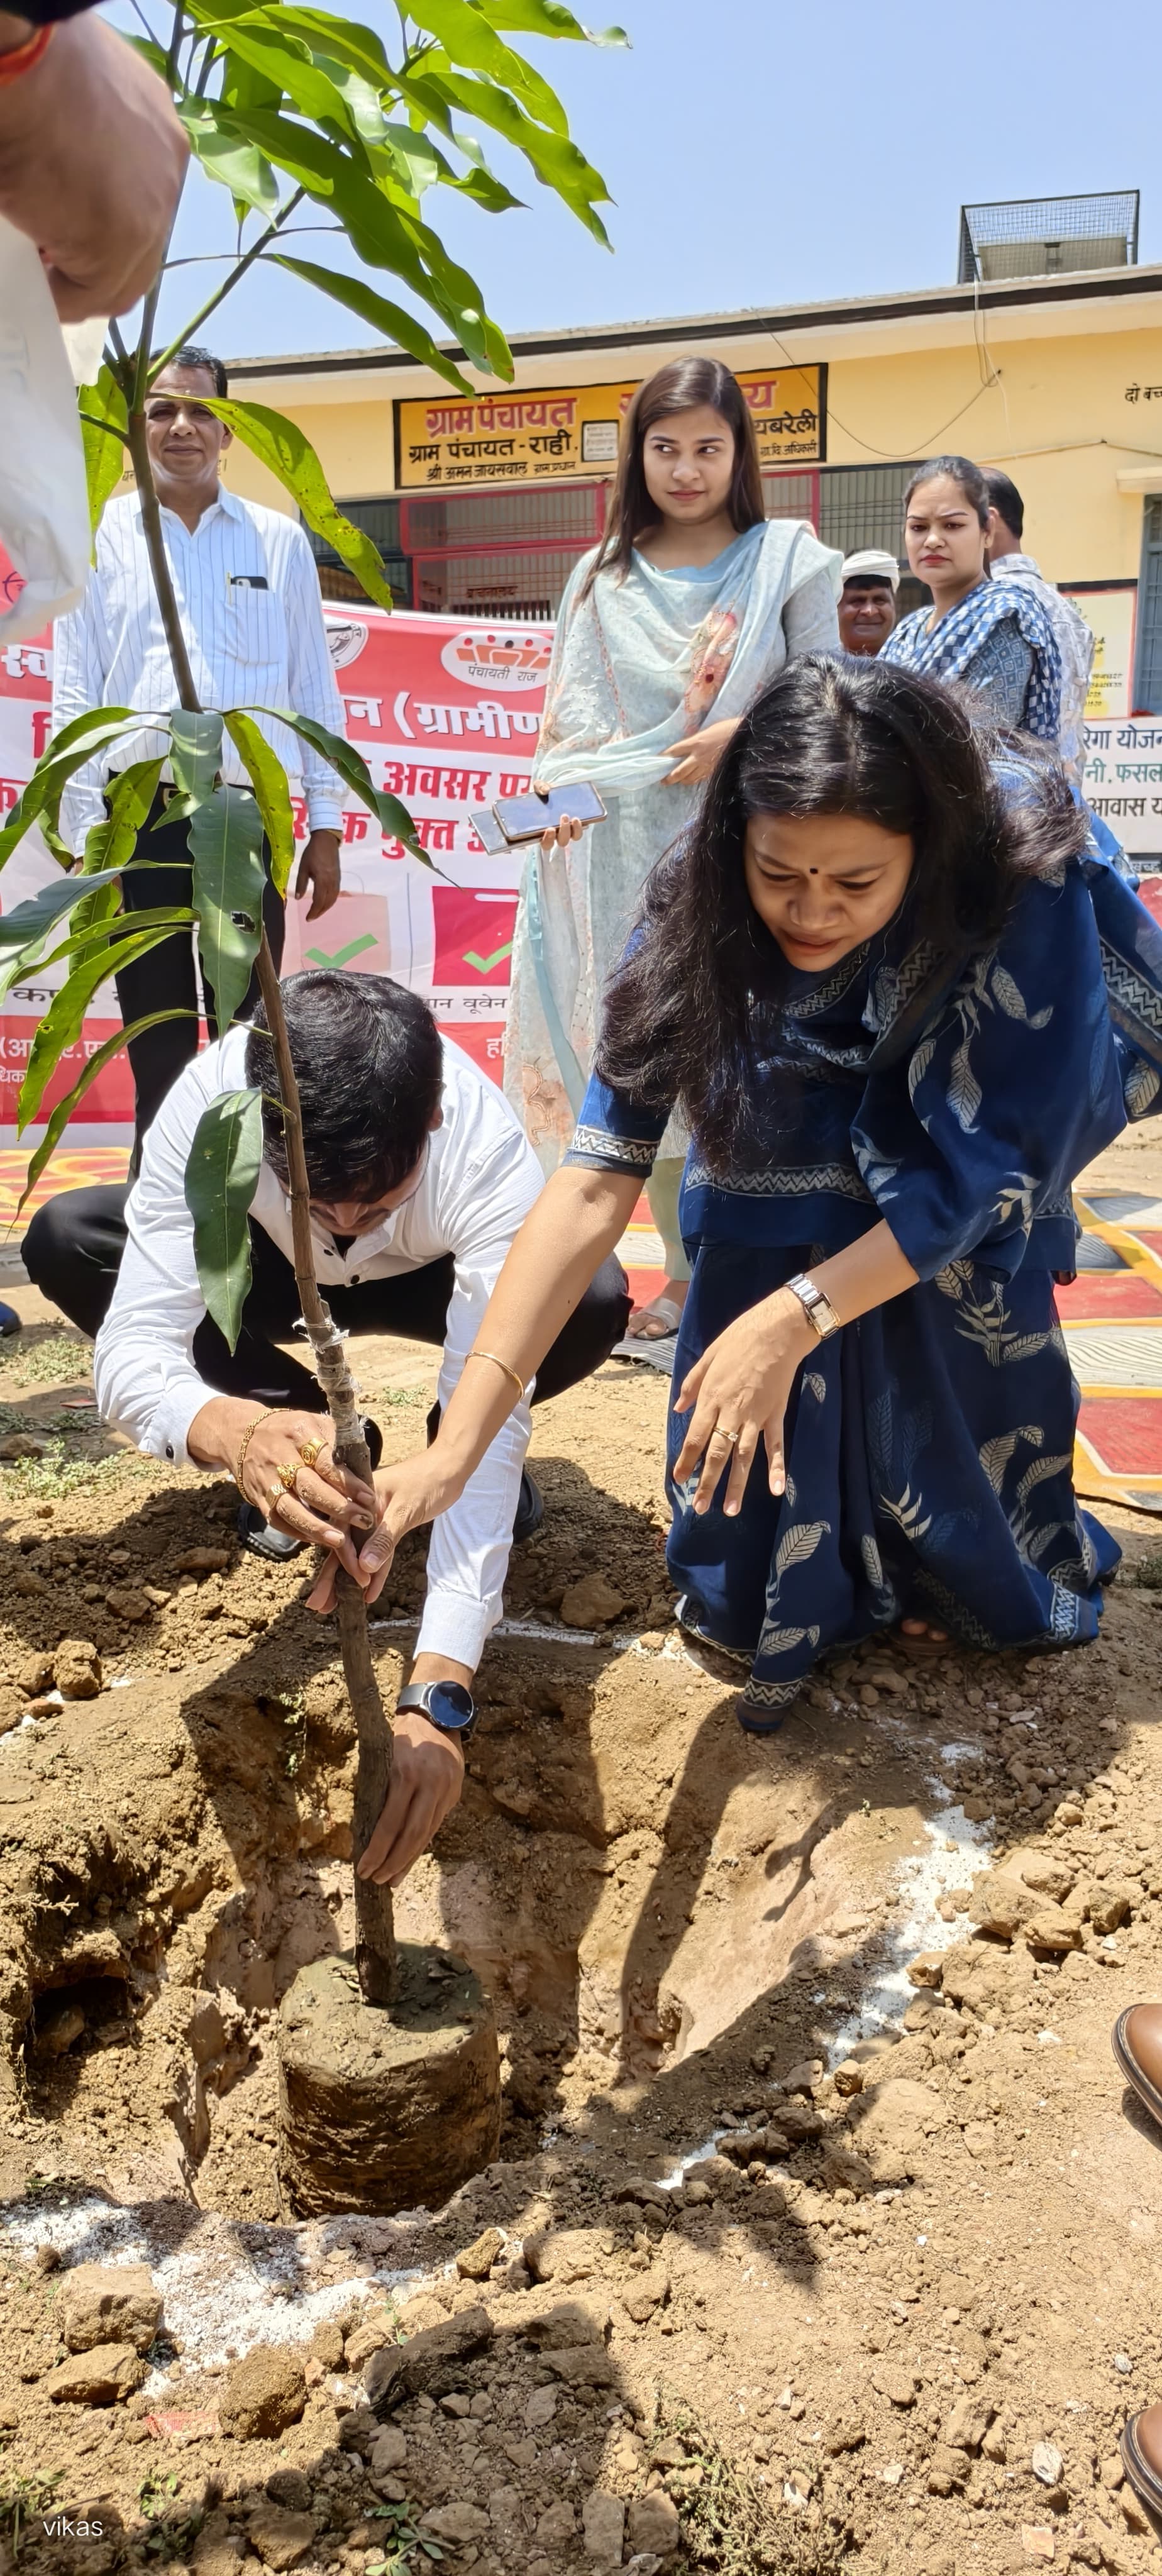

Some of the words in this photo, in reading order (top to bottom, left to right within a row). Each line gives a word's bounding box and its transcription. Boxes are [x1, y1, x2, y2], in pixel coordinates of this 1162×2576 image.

[1125, 382, 1141, 404] दो
[426, 406, 475, 439] ग्राम
[477, 397, 578, 431] पंचायत
[754, 408, 817, 435] यबरेली
[409, 444, 441, 464] ग्राम
[467, 662, 511, 680] पंचायती
[517, 670, 539, 683] राज
[382, 760, 491, 802] अवसर
